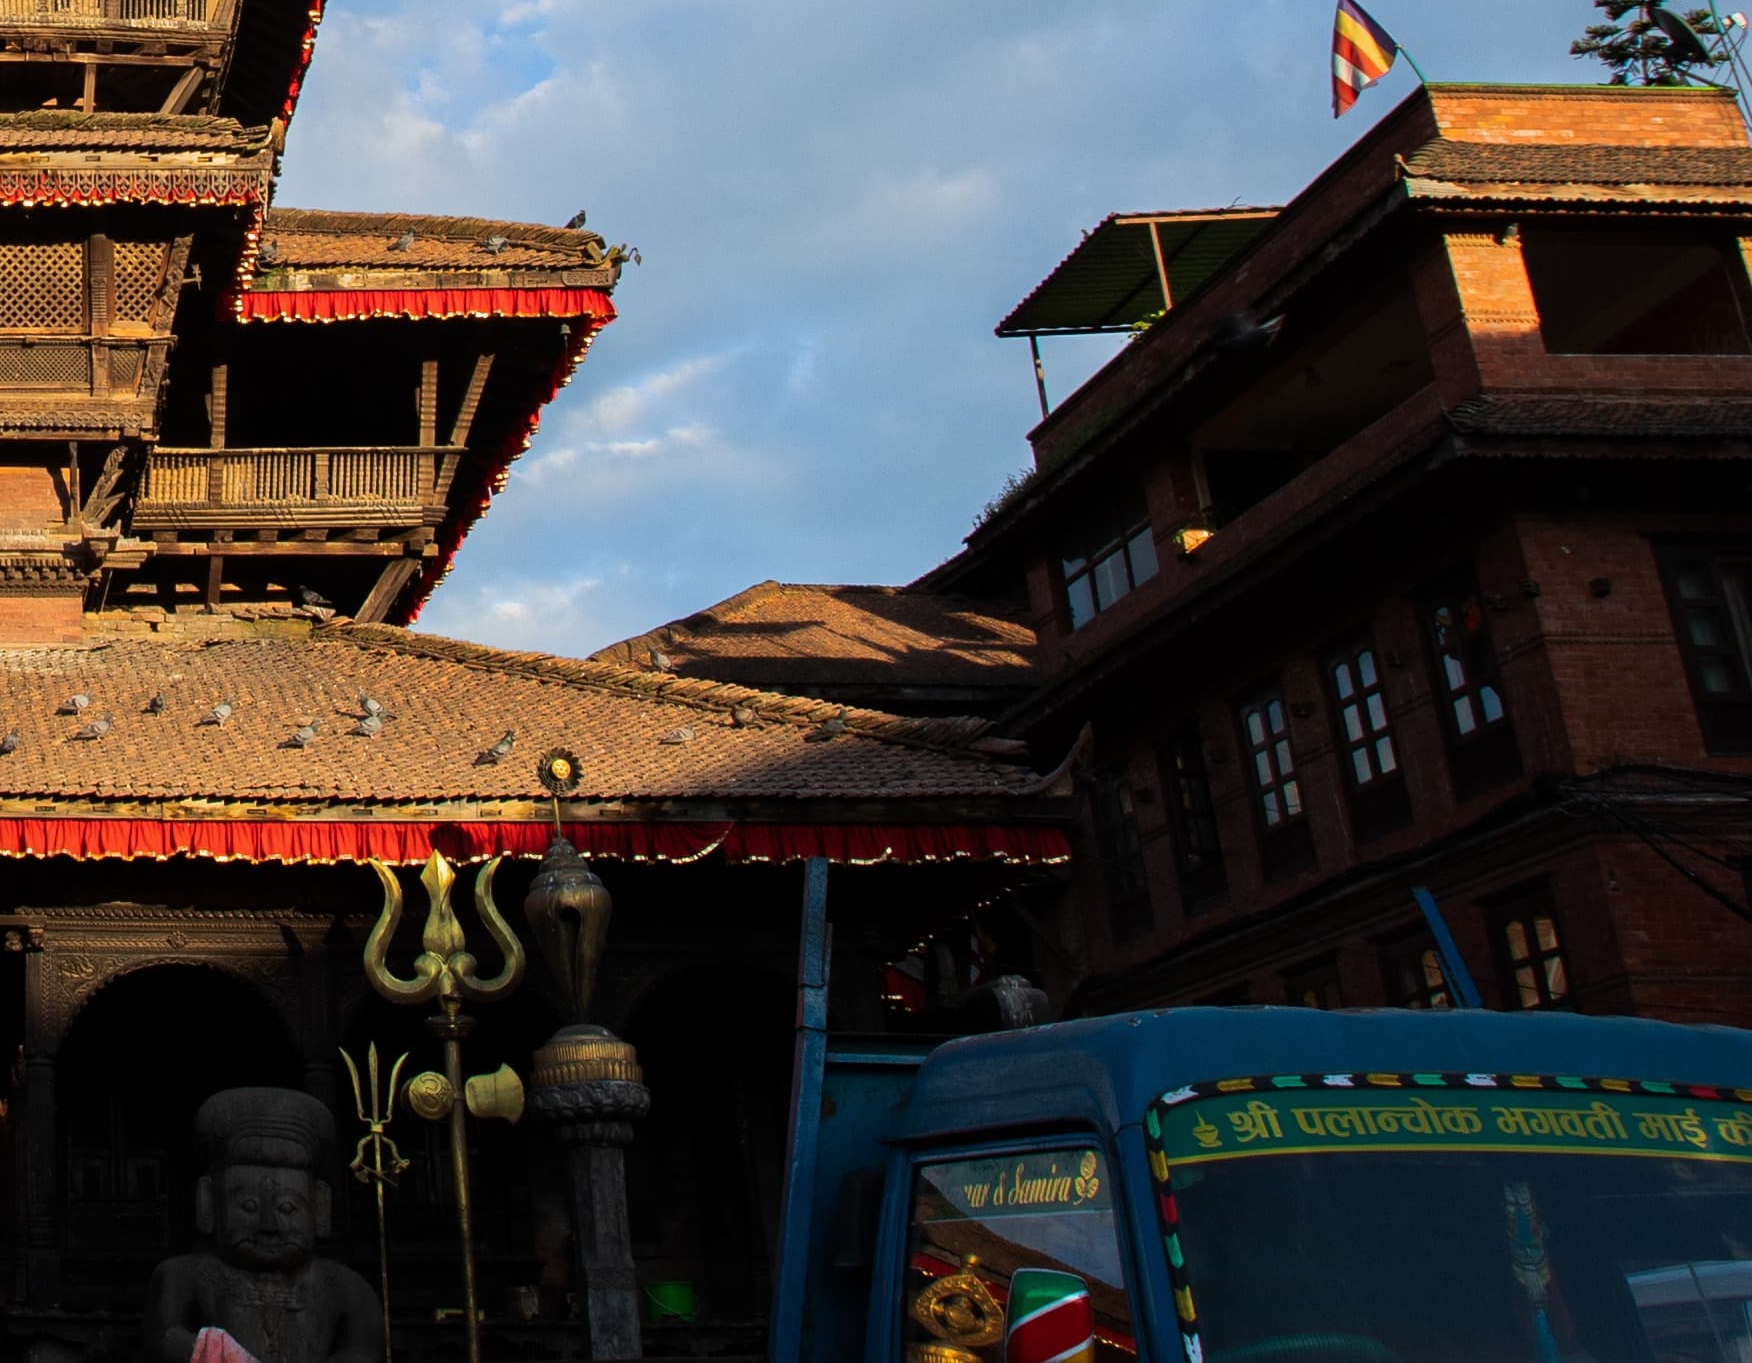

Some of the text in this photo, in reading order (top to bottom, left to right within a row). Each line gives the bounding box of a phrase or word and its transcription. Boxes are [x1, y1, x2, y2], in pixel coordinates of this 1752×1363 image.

[1227, 1100, 1284, 1142] श्री
[1290, 1097, 1482, 1137] पलान्चोक
[1490, 1101, 1629, 1139] भगवती
[1632, 1108, 1708, 1149] माई
[1008, 1162, 1072, 1205] Samira
